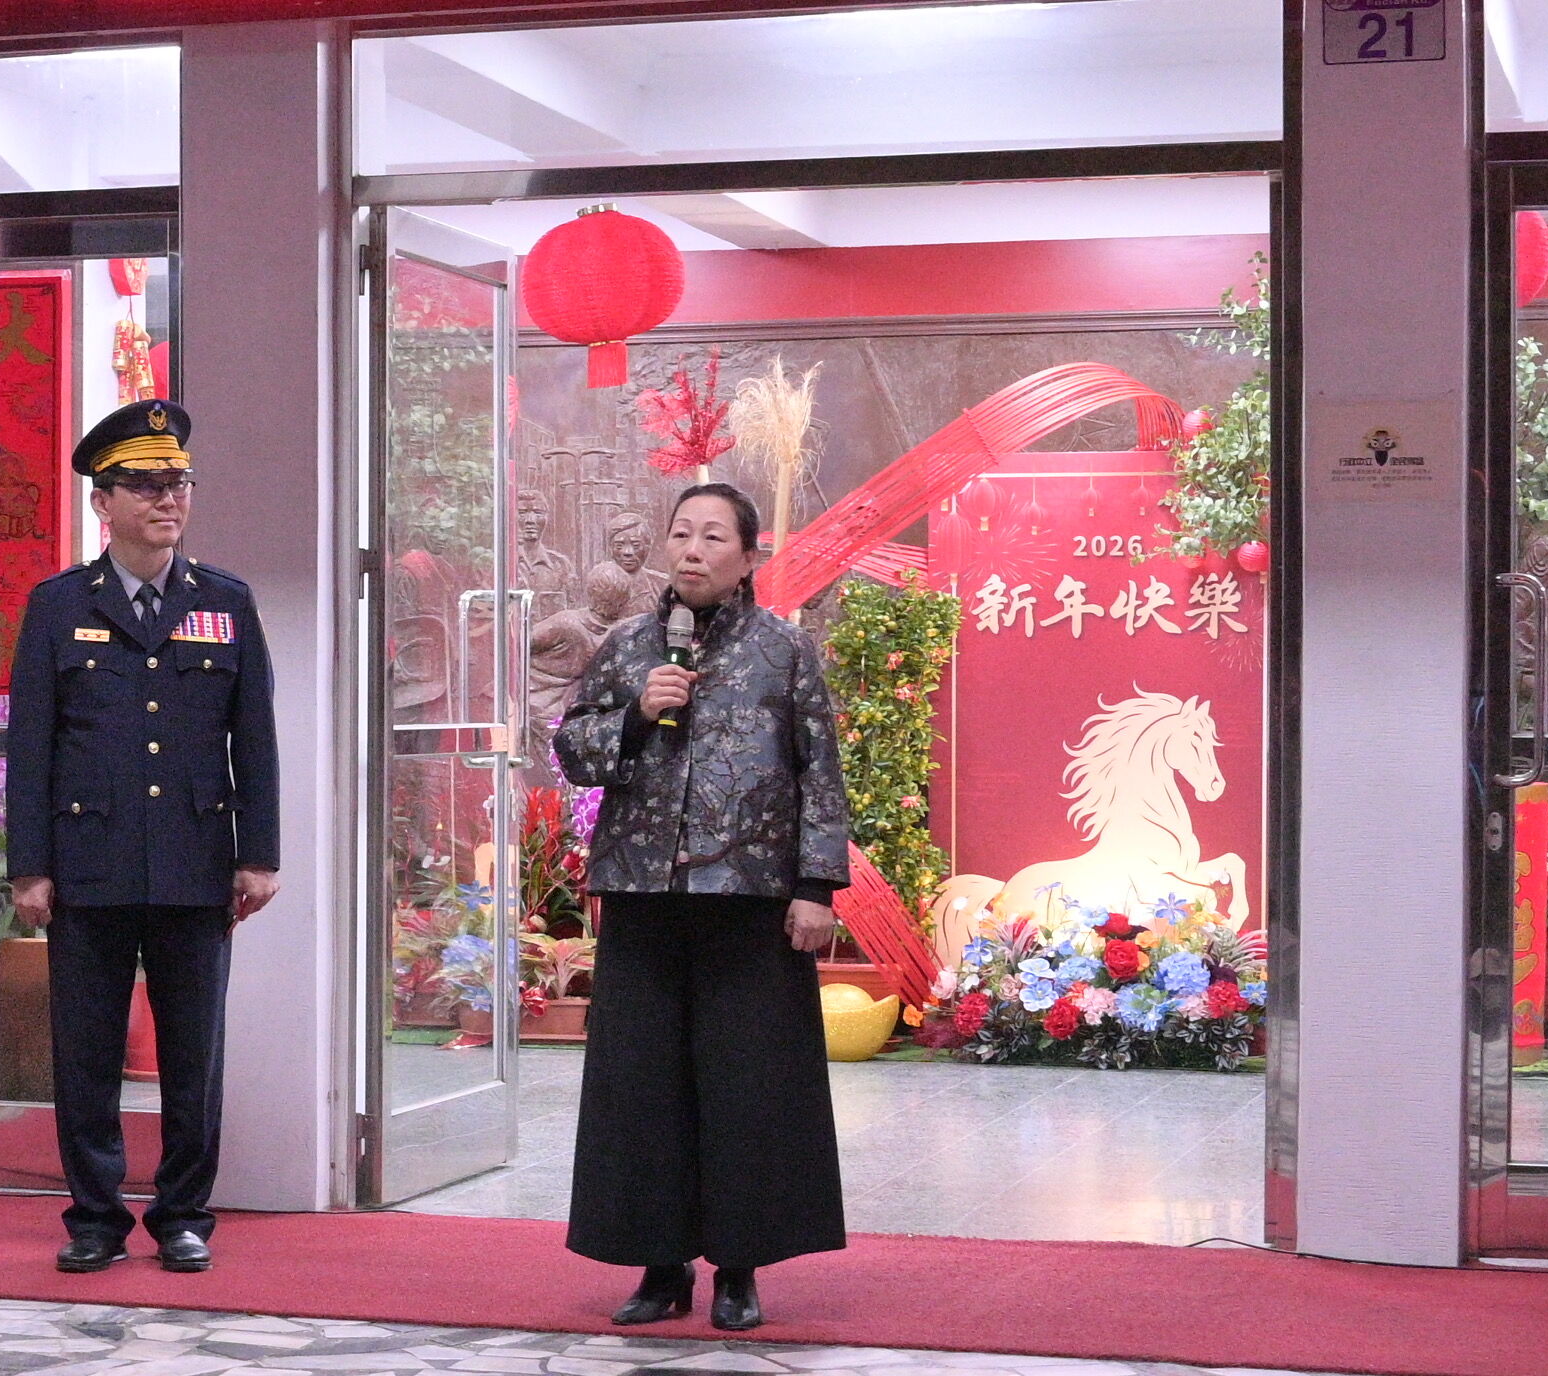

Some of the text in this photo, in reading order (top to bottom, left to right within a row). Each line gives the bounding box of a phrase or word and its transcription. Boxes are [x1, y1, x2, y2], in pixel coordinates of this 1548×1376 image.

[1357, 11, 1414, 59] 21
[1072, 535, 1144, 558] 2026
[971, 571, 1250, 640] 新年快樂
